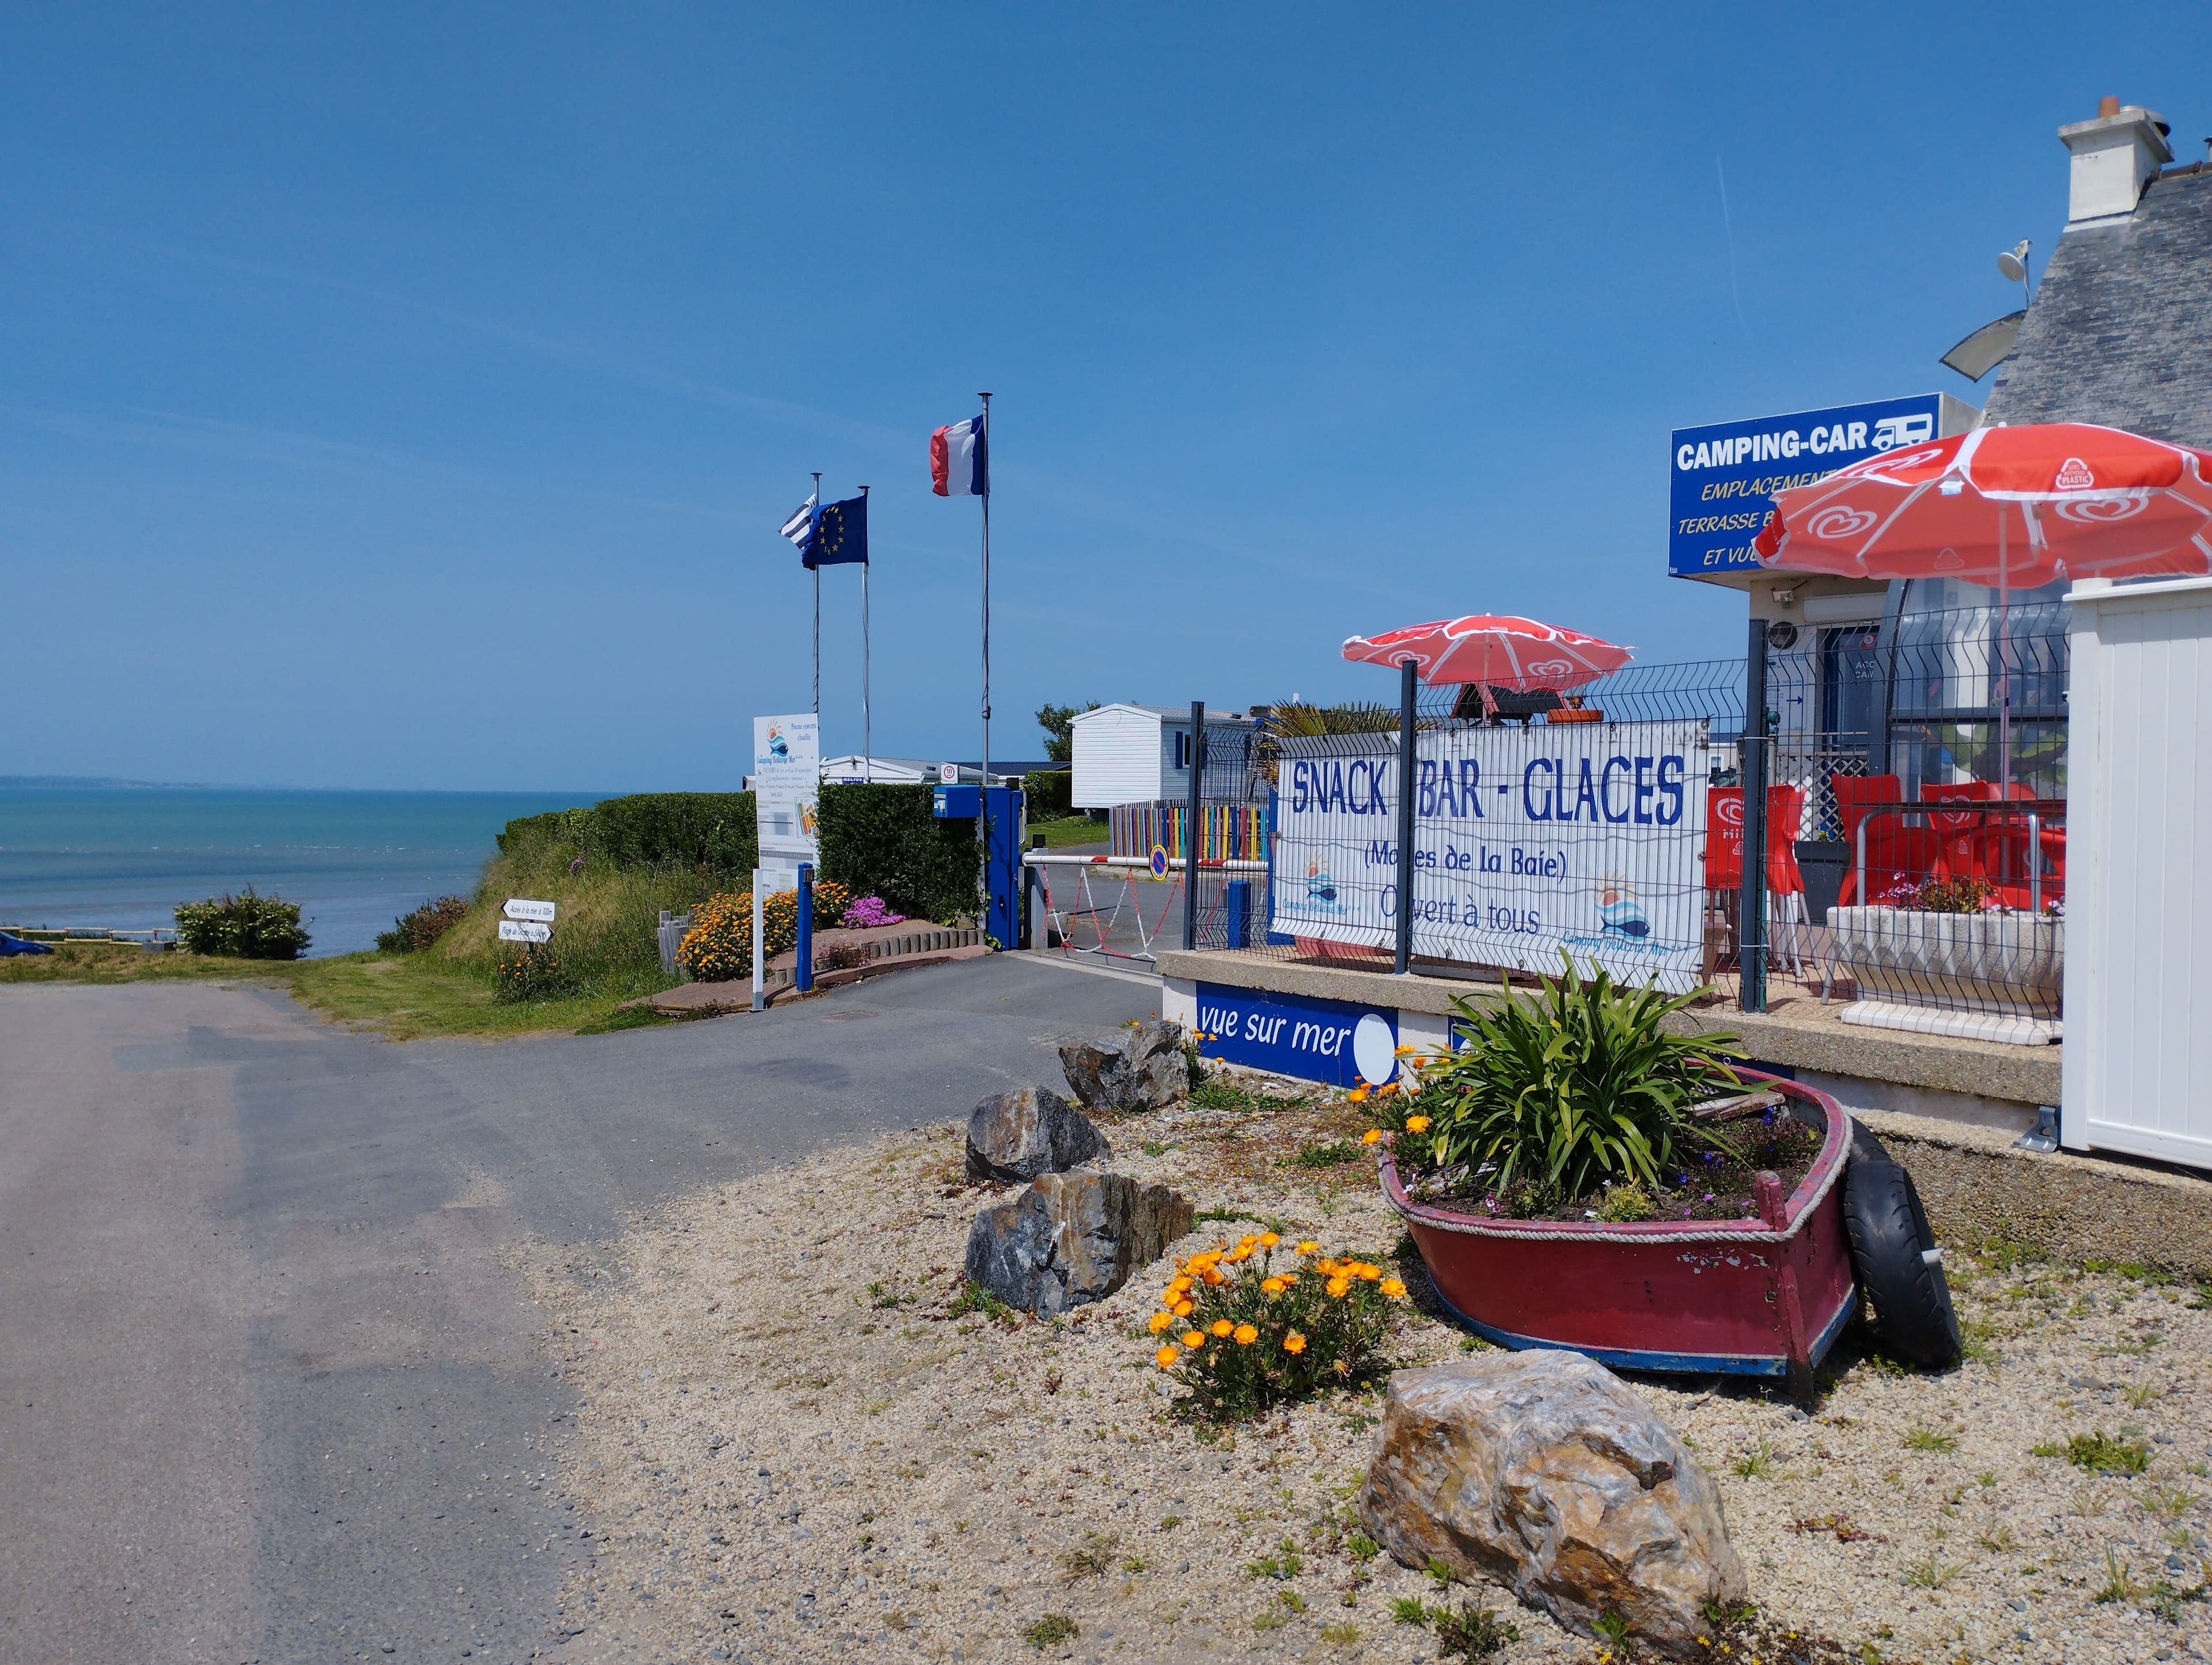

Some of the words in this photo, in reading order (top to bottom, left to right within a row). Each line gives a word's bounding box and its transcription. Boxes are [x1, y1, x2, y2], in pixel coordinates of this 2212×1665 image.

[1677, 422, 1868, 471] CAMPING-CAR
[2062, 476, 2089, 484] PLASTIC
[1679, 512, 1760, 535] TERRASSE
[1703, 548, 1726, 566] ET
[757, 756, 772, 765] Camping
[1293, 759, 1388, 816] SNACK
[1418, 758, 1485, 818] BAR
[1523, 754, 1684, 825] GLACES
[1445, 844, 1471, 871] de
[1480, 845, 1501, 873] la
[510, 905, 521, 913] Accès
[1283, 898, 1307, 913] Camping
[1309, 900, 1334, 914] Bellevue
[1380, 884, 1457, 925] Overt
[1463, 893, 1479, 928] à
[1488, 897, 1540, 935] tous
[1563, 930, 1600, 953] Camping
[1604, 935, 1646, 954] Bellevue
[1202, 1006, 1238, 1037] vue
[1245, 1013, 1287, 1045] sur
[1291, 1021, 1351, 1057] mer
